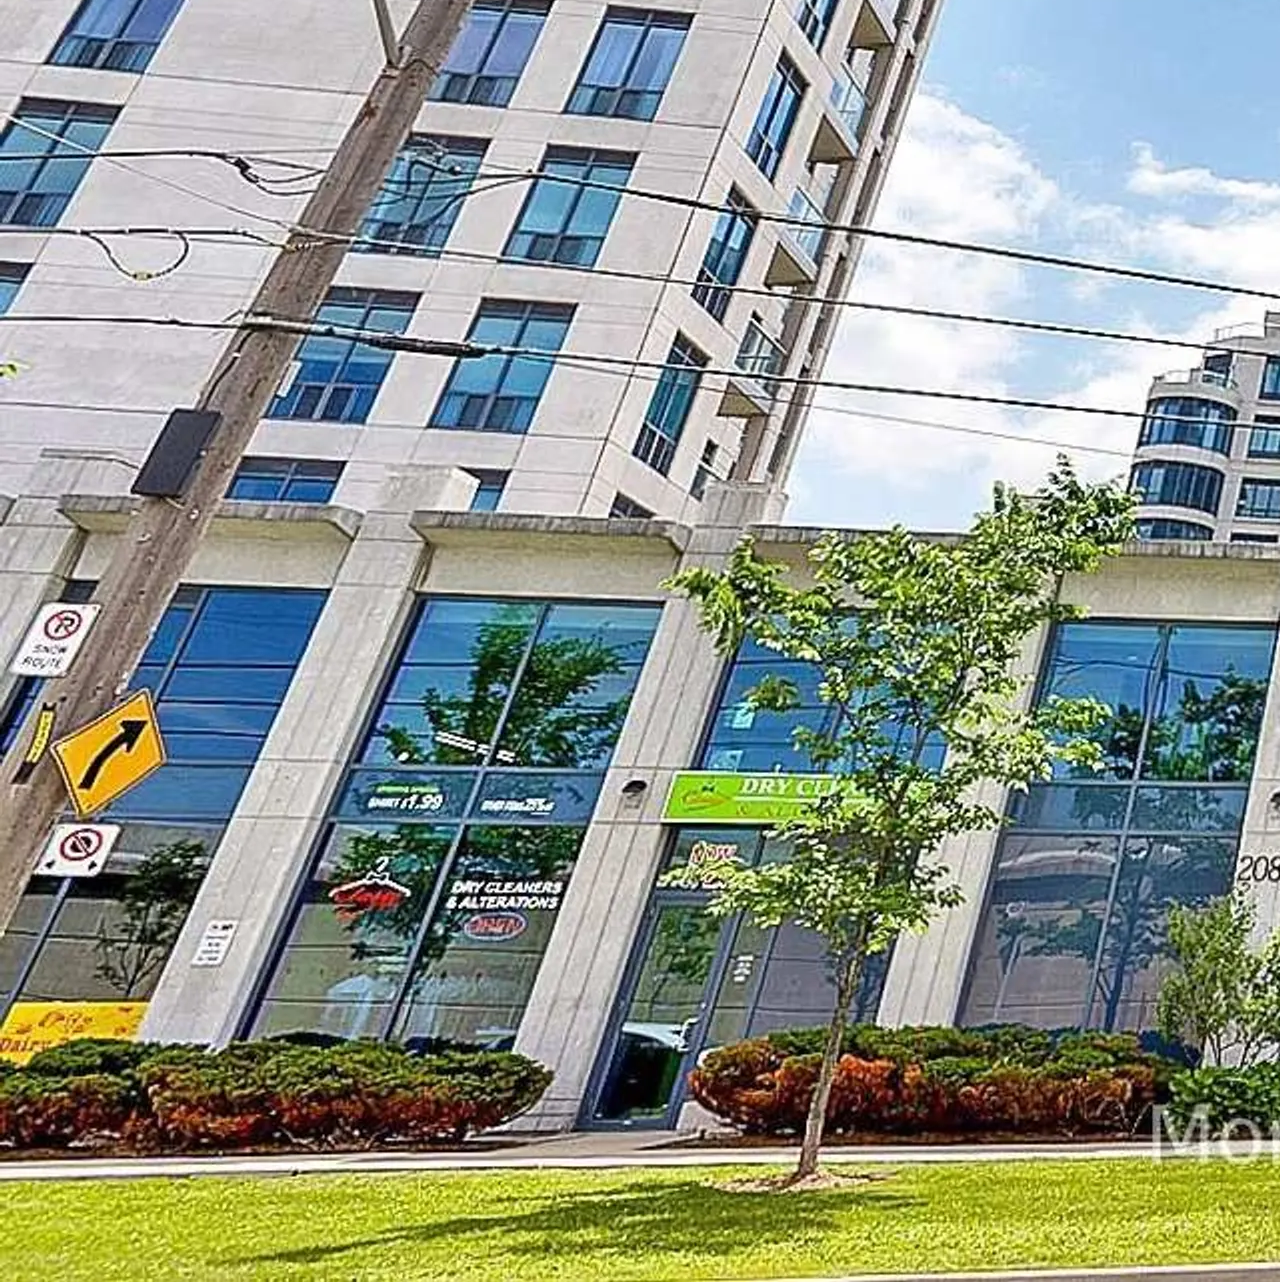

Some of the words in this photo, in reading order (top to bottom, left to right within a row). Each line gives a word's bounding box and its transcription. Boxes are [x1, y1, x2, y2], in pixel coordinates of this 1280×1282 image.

[32, 644, 68, 654] SNOW
[22, 656, 64, 669] ROUTE
[739, 778, 795, 795] DRY
[451, 880, 485, 894] DRY
[484, 880, 564, 895] CLEANERS
[458, 896, 560, 910] ALTERATIONS
